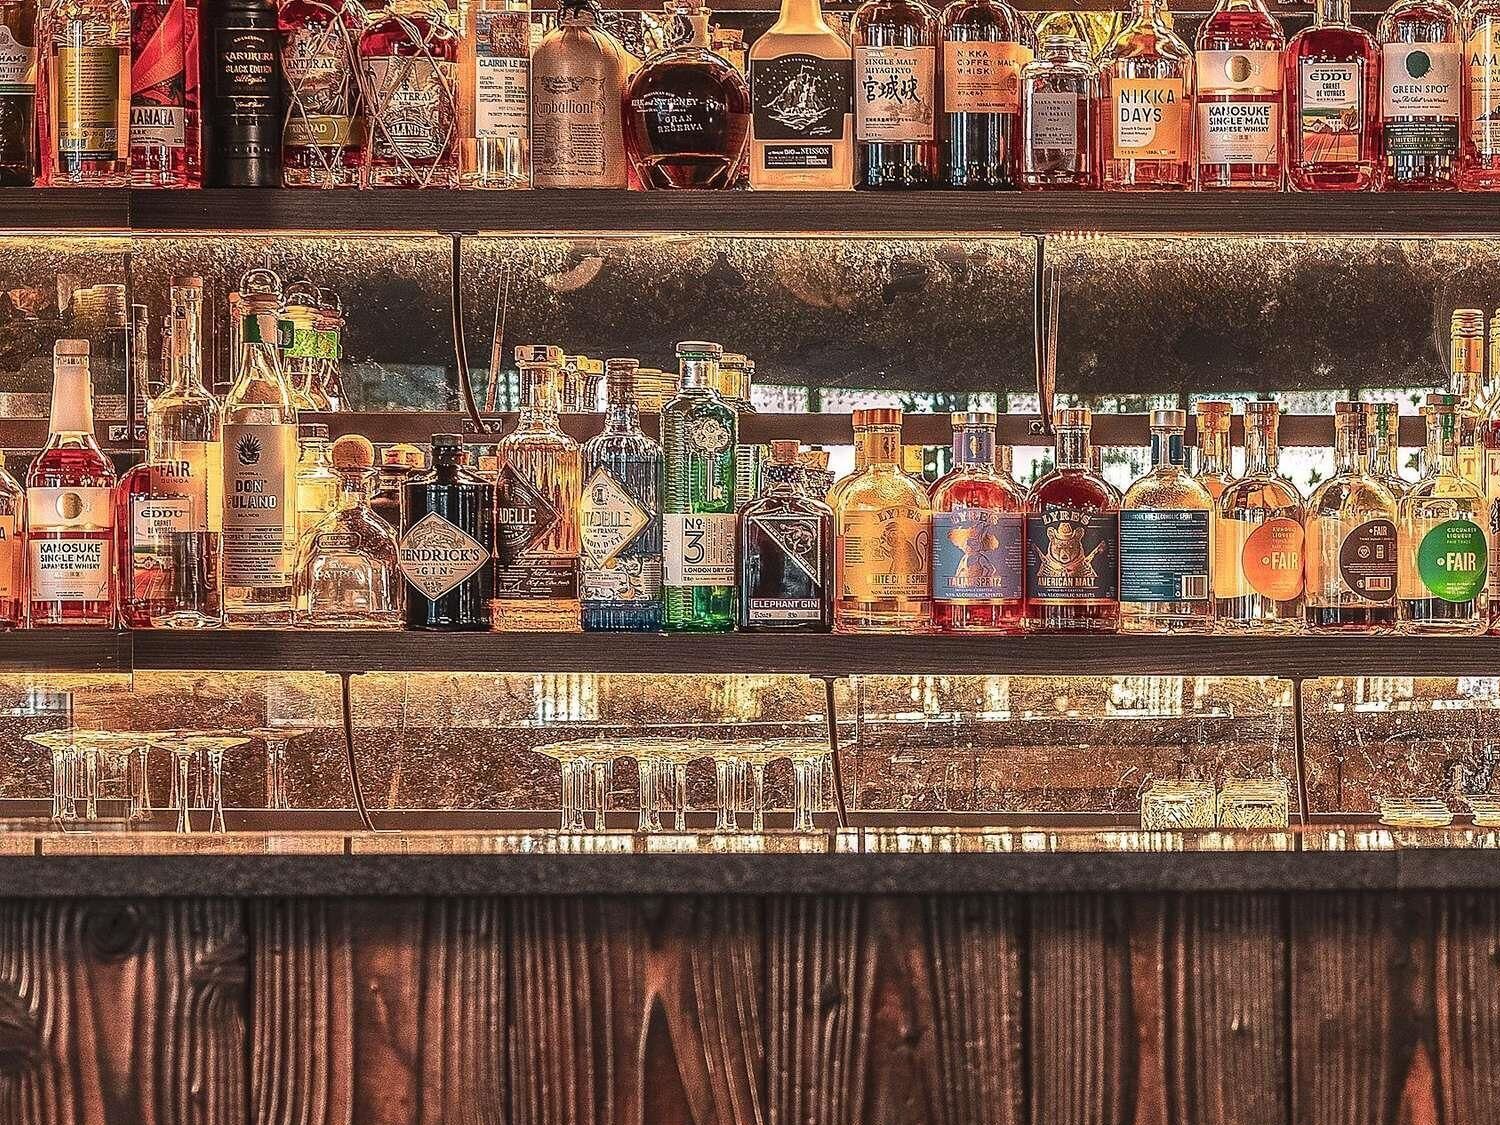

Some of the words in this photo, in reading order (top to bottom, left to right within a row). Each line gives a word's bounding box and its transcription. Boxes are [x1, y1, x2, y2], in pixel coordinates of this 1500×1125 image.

[1393, 85, 1422, 93] GREEN
[1425, 85, 1448, 93] SPOT
[654, 97, 698, 106] SWEENEY
[1121, 90, 1175, 104] NIKKA
[1121, 108, 1162, 123] DAYS
[1209, 106, 1269, 116] KANOSUKE
[665, 115, 692, 123] GRAN
[1209, 117, 1242, 125] SINGLE
[1245, 117, 1269, 125] MALT
[657, 123, 703, 133] RESERVA
[236, 480, 263, 492] DON
[225, 495, 277, 508] ULANO
[876, 509, 922, 523] LYE'S
[1041, 511, 1092, 525] LYRE'S
[1373, 526, 1388, 535] FAIR
[40, 543, 100, 552] KANOSUKE
[684, 531, 704, 564] 3
[41, 554, 73, 562] SINGLE
[401, 549, 479, 561] HENDRICK'S
[1272, 552, 1298, 569] FAIR
[1446, 553, 1476, 571] FAIR
[422, 567, 448, 575] GIN
[872, 575, 890, 584] HITE
[947, 577, 975, 587] ITALIA
[1038, 577, 1073, 587] AMERICAN
[1075, 577, 1095, 586] MALT
